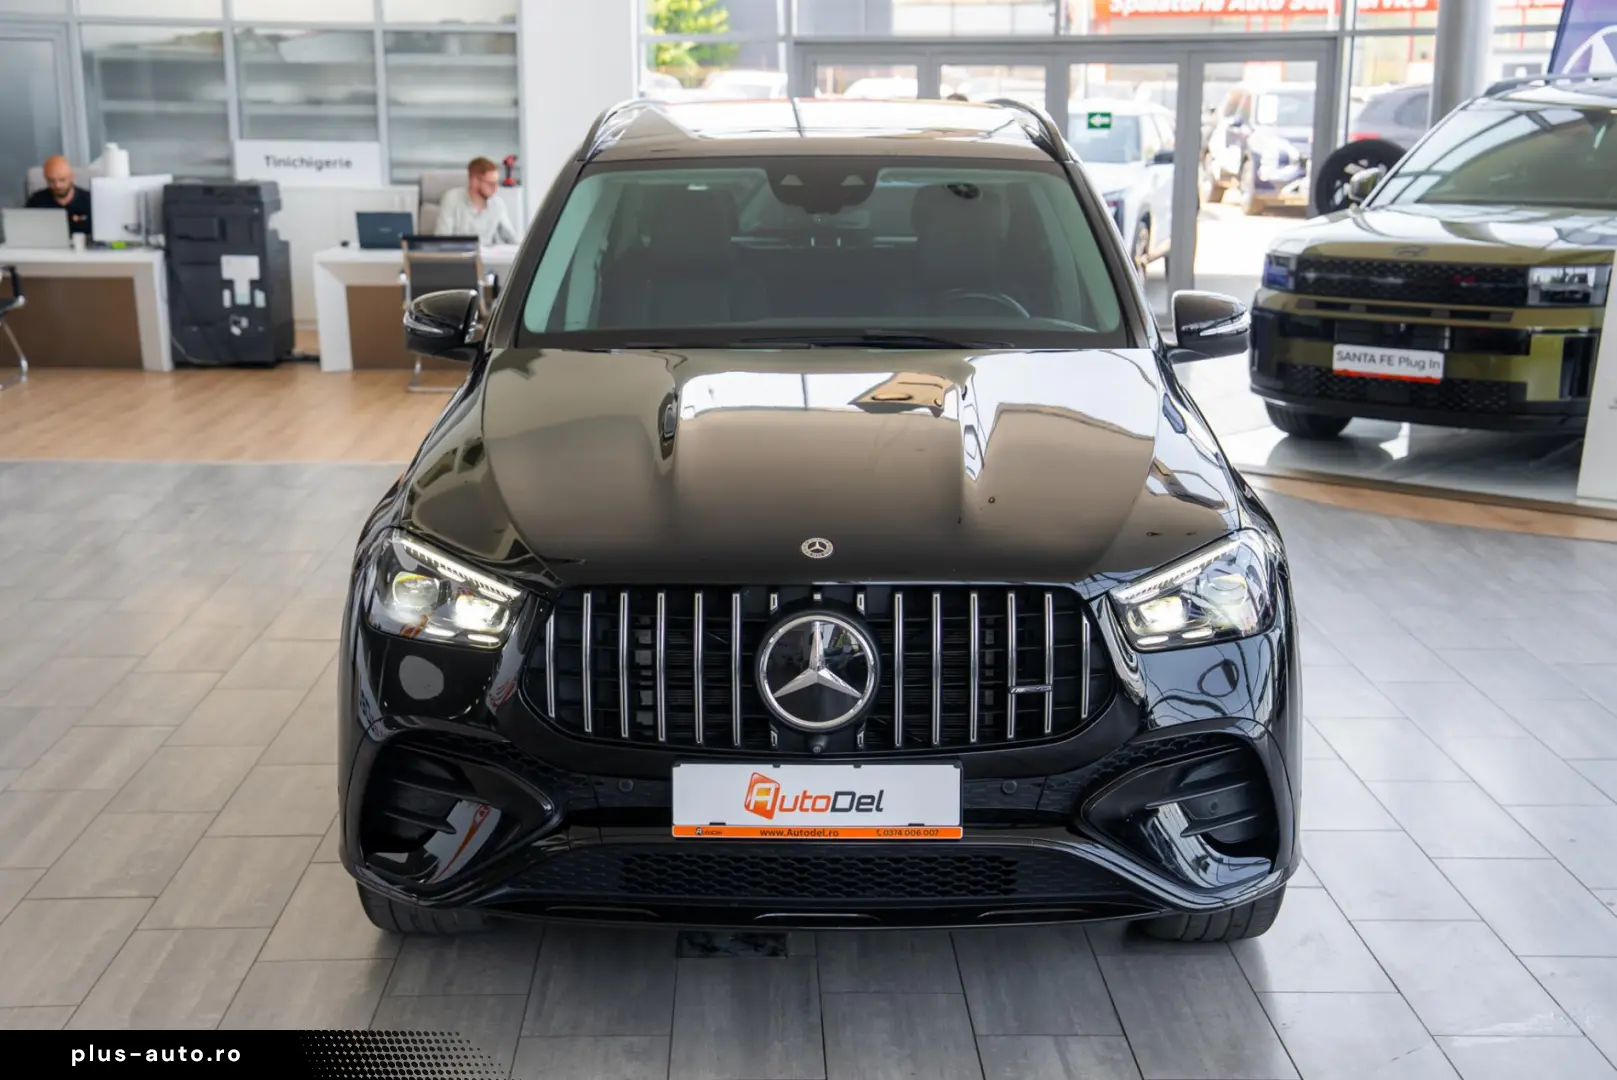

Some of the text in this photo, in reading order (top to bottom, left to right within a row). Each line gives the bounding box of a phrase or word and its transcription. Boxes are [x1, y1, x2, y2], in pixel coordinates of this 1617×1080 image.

[263, 154, 353, 172] Tinichigerie
[1336, 350, 1441, 372] SANTA FE Plug In
[748, 778, 885, 814] AutoDel
[759, 828, 840, 838] www.Autodel.ro
